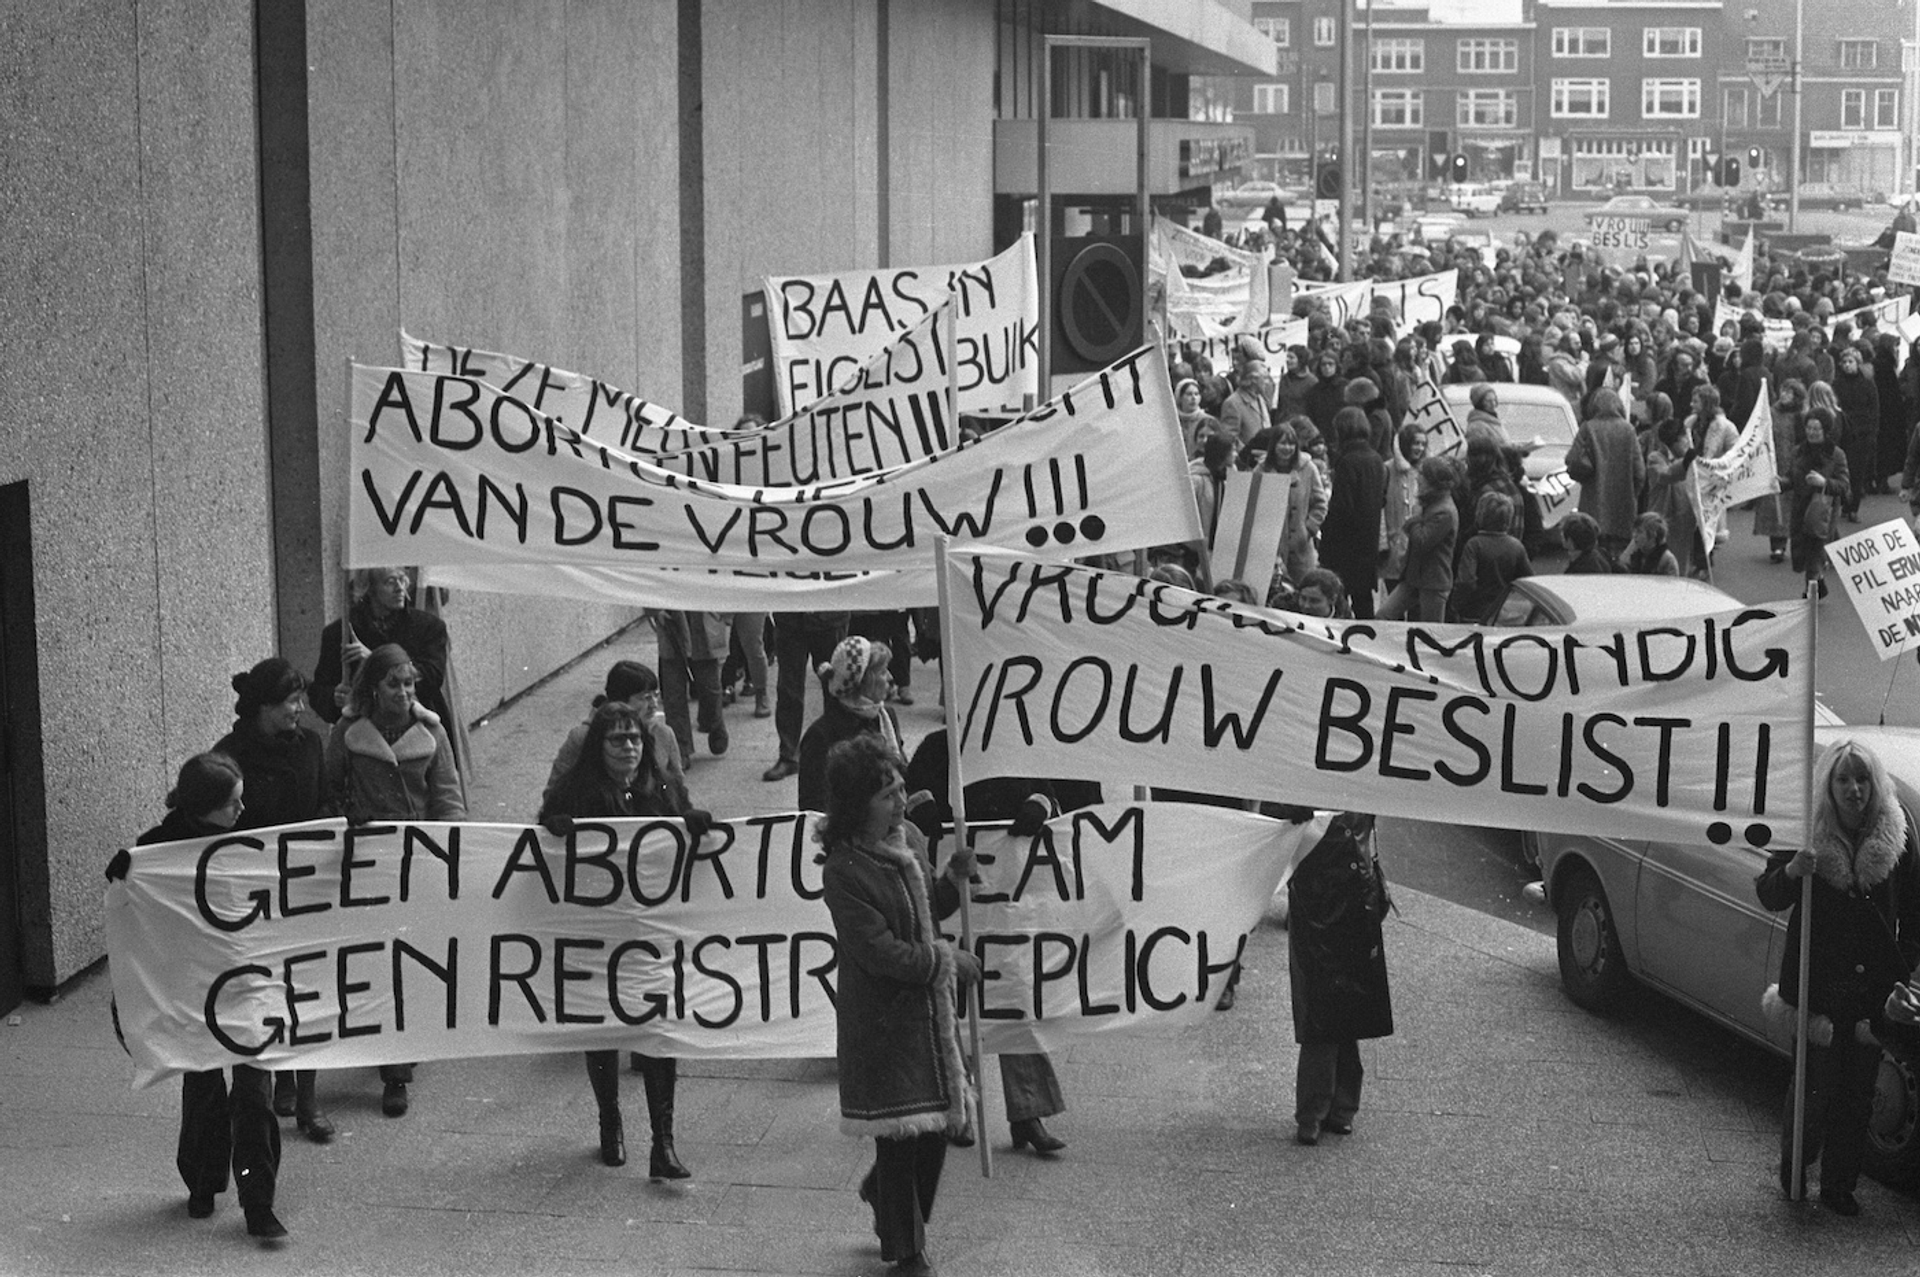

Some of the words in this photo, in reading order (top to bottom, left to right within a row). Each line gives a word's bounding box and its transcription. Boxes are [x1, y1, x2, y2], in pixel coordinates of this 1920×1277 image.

[1593, 231, 1649, 249] BESLIS
[1594, 217, 1650, 234] VROUW
[781, 271, 929, 340] BAAS
[957, 316, 1040, 392] BUIK
[361, 468, 528, 545] VAN
[550, 486, 660, 550] DE
[1837, 538, 1880, 567] VOOR
[1882, 529, 1907, 551] DE
[1851, 569, 1888, 594] PIL
[1887, 552, 1920, 581] ERN
[1881, 583, 1920, 614] NAAR
[1406, 608, 1790, 700] MONDIG
[1878, 623, 1906, 648] DE
[195, 825, 461, 932] GEEN
[205, 936, 458, 1057] GEEN
